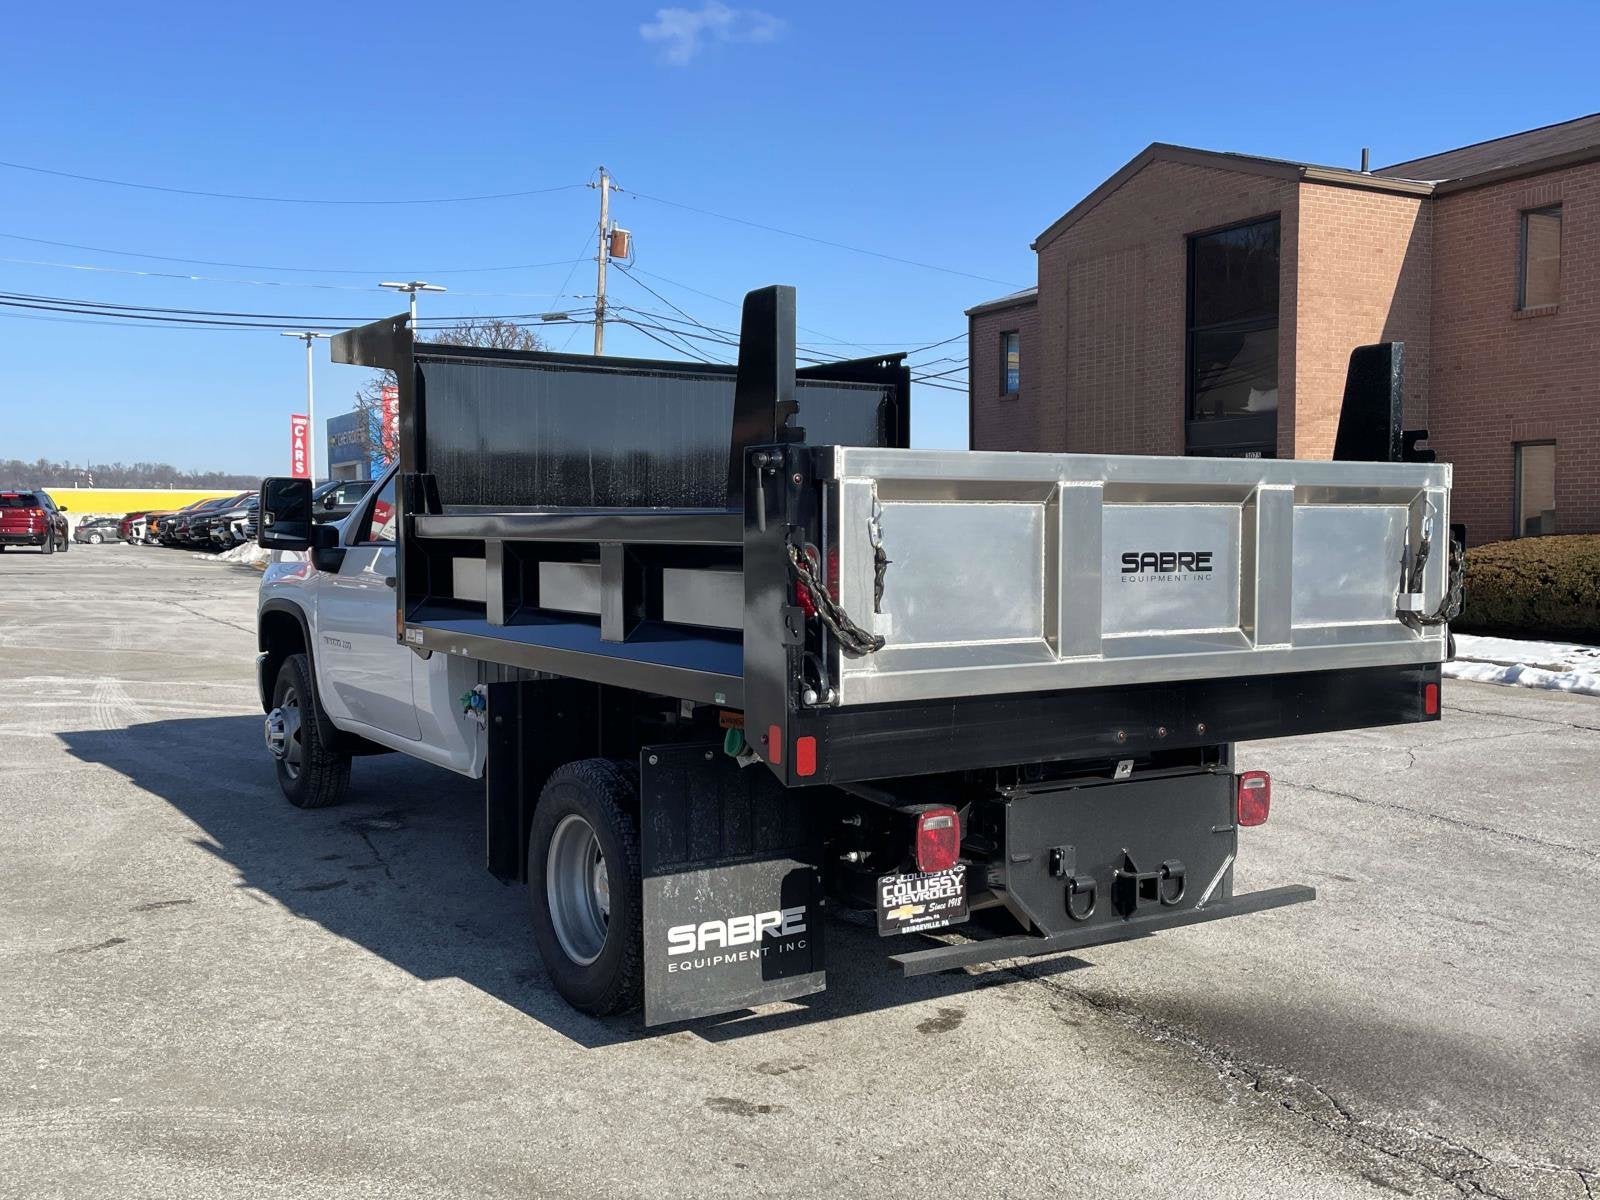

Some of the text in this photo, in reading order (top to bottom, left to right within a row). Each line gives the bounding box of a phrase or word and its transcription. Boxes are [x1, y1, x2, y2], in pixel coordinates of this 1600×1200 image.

[294, 425, 304, 473] CARS
[1121, 551, 1213, 573] SABRE
[1121, 573, 1212, 583] EQUIPMENT INC
[882, 873, 964, 899] COLUSSY
[883, 884, 963, 908] CHEVROLET
[928, 897, 963, 912] Since 1918
[667, 905, 806, 956] SABRE
[667, 939, 807, 973] EQUIPMENT INC
